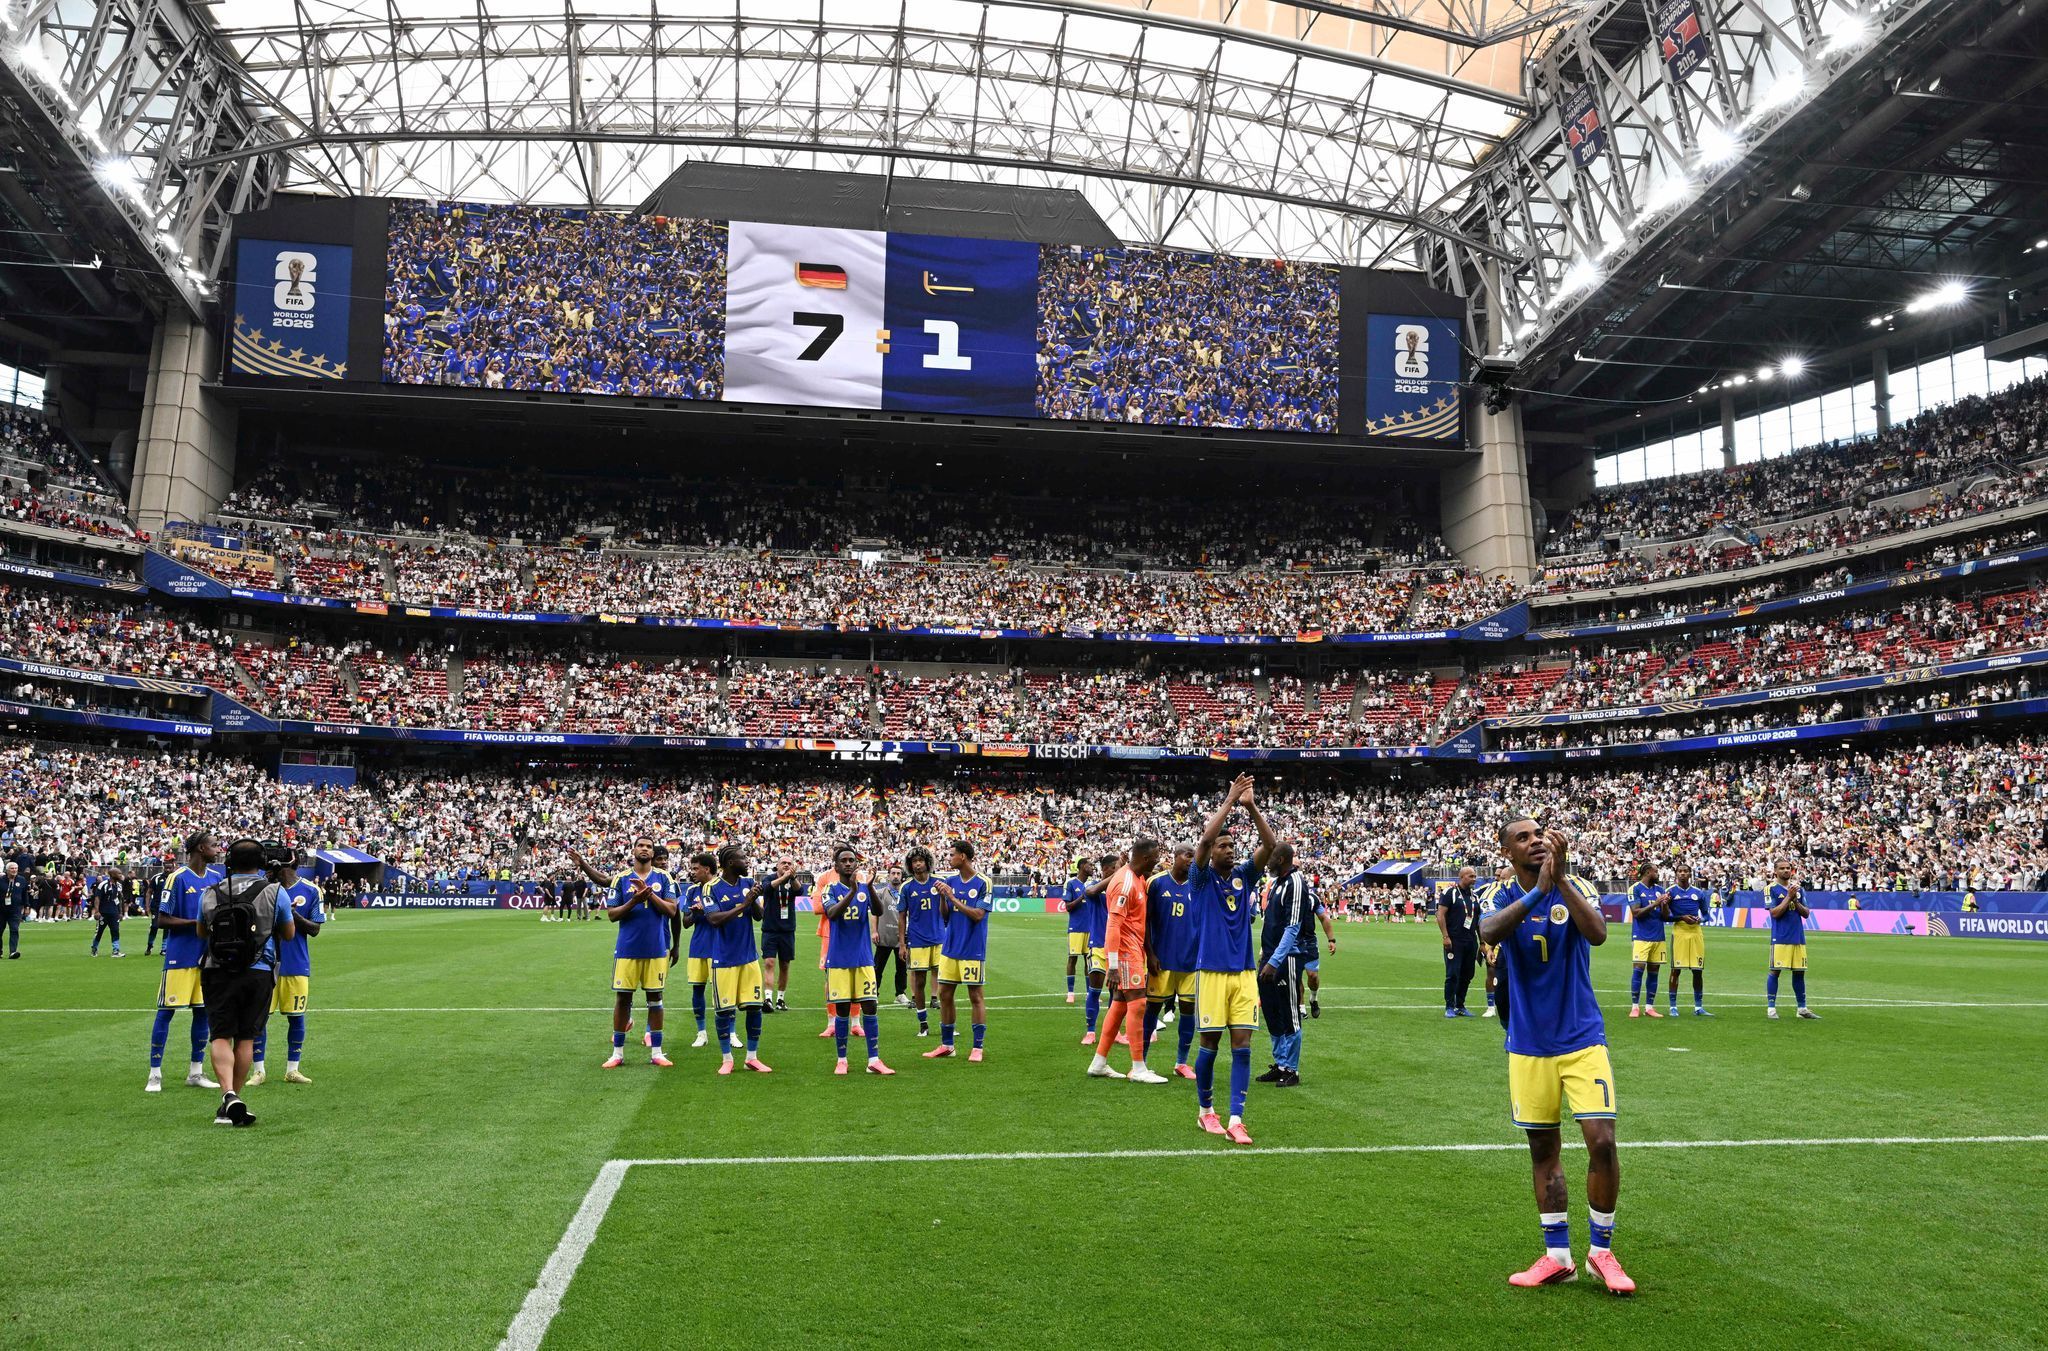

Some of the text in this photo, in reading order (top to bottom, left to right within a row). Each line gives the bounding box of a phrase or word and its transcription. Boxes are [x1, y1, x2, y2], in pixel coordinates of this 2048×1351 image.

[1658, 0, 1690, 34] CHAMPIONS
[1660, 8, 1669, 21] AFC
[1676, 49, 1698, 75] 2012
[1566, 89, 1587, 111] AFC SOUTH
[1581, 140, 1596, 161] 2011
[286, 298, 304, 306] FIFA
[273, 311, 299, 319] WORLD
[272, 318, 314, 329] 2026
[793, 311, 844, 361] 7
[923, 319, 971, 370] 1
[1394, 385, 1428, 394] 2026
[242, 554, 268, 563] 2026
[10, 565, 26, 573] CUP
[27, 568, 54, 578] 2026
[1799, 590, 1845, 604] HOUSTON
[1631, 622, 1652, 630] WORLD
[1665, 617, 1686, 625] 2026
[23, 664, 104, 682] FIFA WORLD CUP 2026
[1769, 686, 1817, 698] HOUSTON
[1569, 708, 1640, 721] FIFA WORLD CUP 2026
[1935, 709, 1978, 722] HOUSTON
[175, 724, 193, 733] FIFA
[314, 725, 359, 735] HOUSTON
[464, 732, 565, 743] FIFA WORLD CUP 2026
[664, 738, 706, 746] HOUSTON
[1718, 729, 1798, 745] FIFA WORLD CUP 2026
[861, 741, 903, 752] 7 1
[998, 743, 1026, 751] WALDSEE
[1035, 745, 1087, 758] KETSCH
[1566, 749, 1601, 758] HOUSTON
[371, 896, 496, 907] ADI PREDICTSTREET
[920, 897, 931, 910] 21
[1226, 894, 1237, 911] 8
[844, 906, 859, 920] 22
[1171, 902, 1184, 917] 19
[1959, 917, 1986, 932] FIFA
[1986, 918, 2033, 934] WORLD
[1532, 934, 1548, 962] 7
[658, 972, 664, 986] 4
[963, 967, 978, 980] 24
[754, 986, 761, 1000] 5
[863, 981, 877, 995] 22
[293, 995, 306, 1010] 13
[1594, 1079, 1610, 1107] 7
